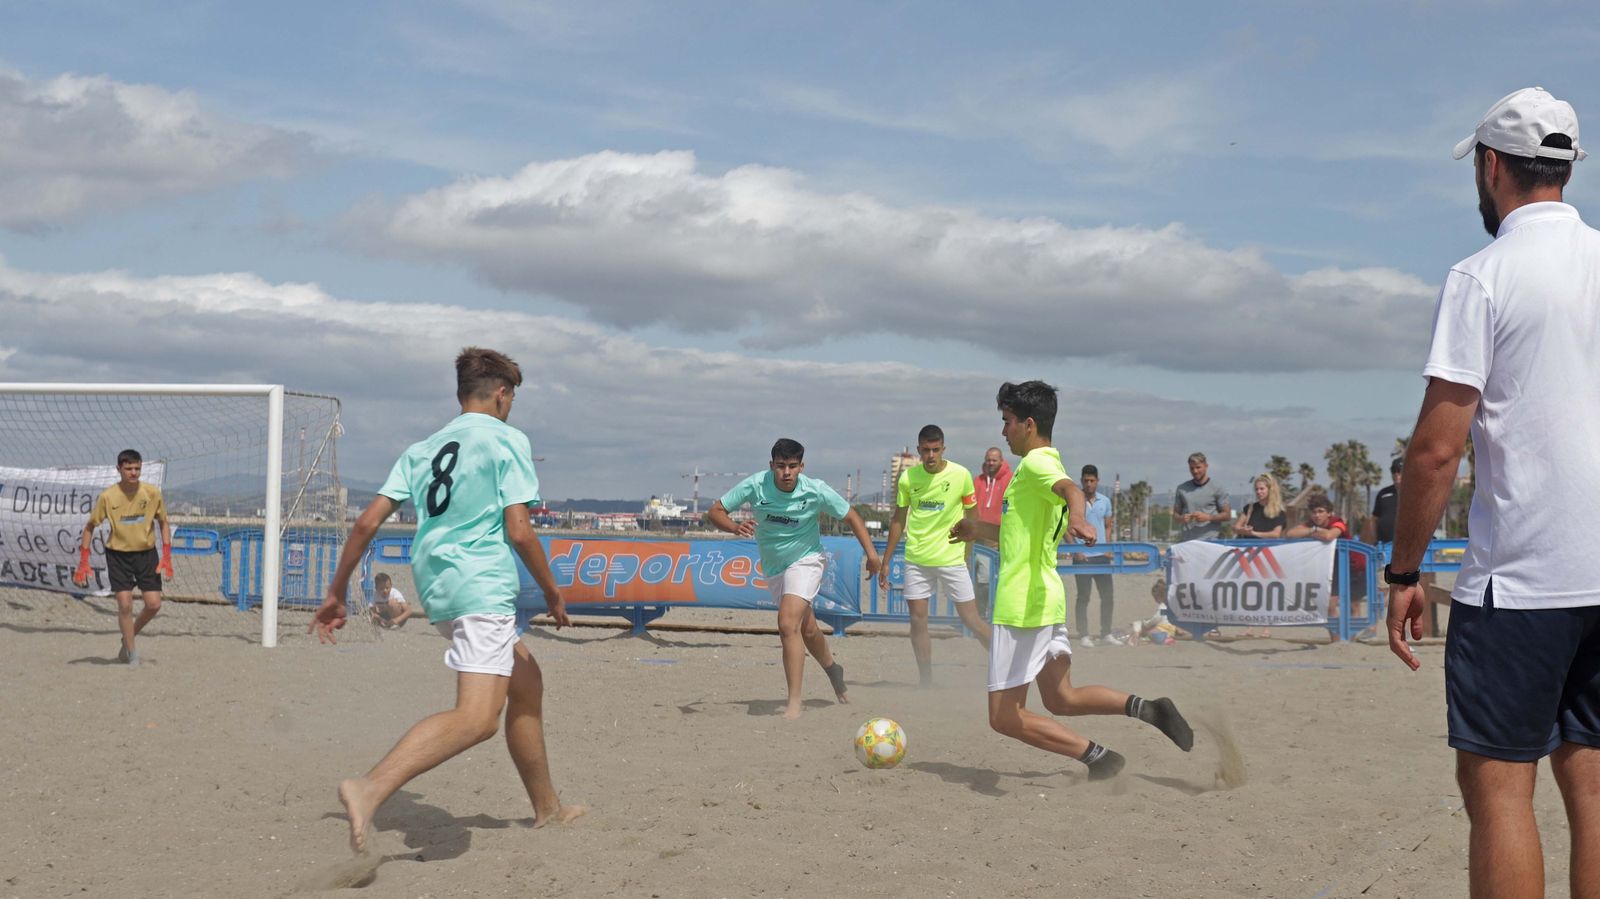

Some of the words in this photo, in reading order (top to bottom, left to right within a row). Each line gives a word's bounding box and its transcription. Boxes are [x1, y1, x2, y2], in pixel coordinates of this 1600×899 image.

[427, 440, 461, 518] 8
[13, 486, 99, 519] Diputa
[17, 528, 49, 553] de
[549, 542, 770, 598] deportes
[1175, 582, 1203, 611] EL
[1212, 580, 1322, 612] MONJE
